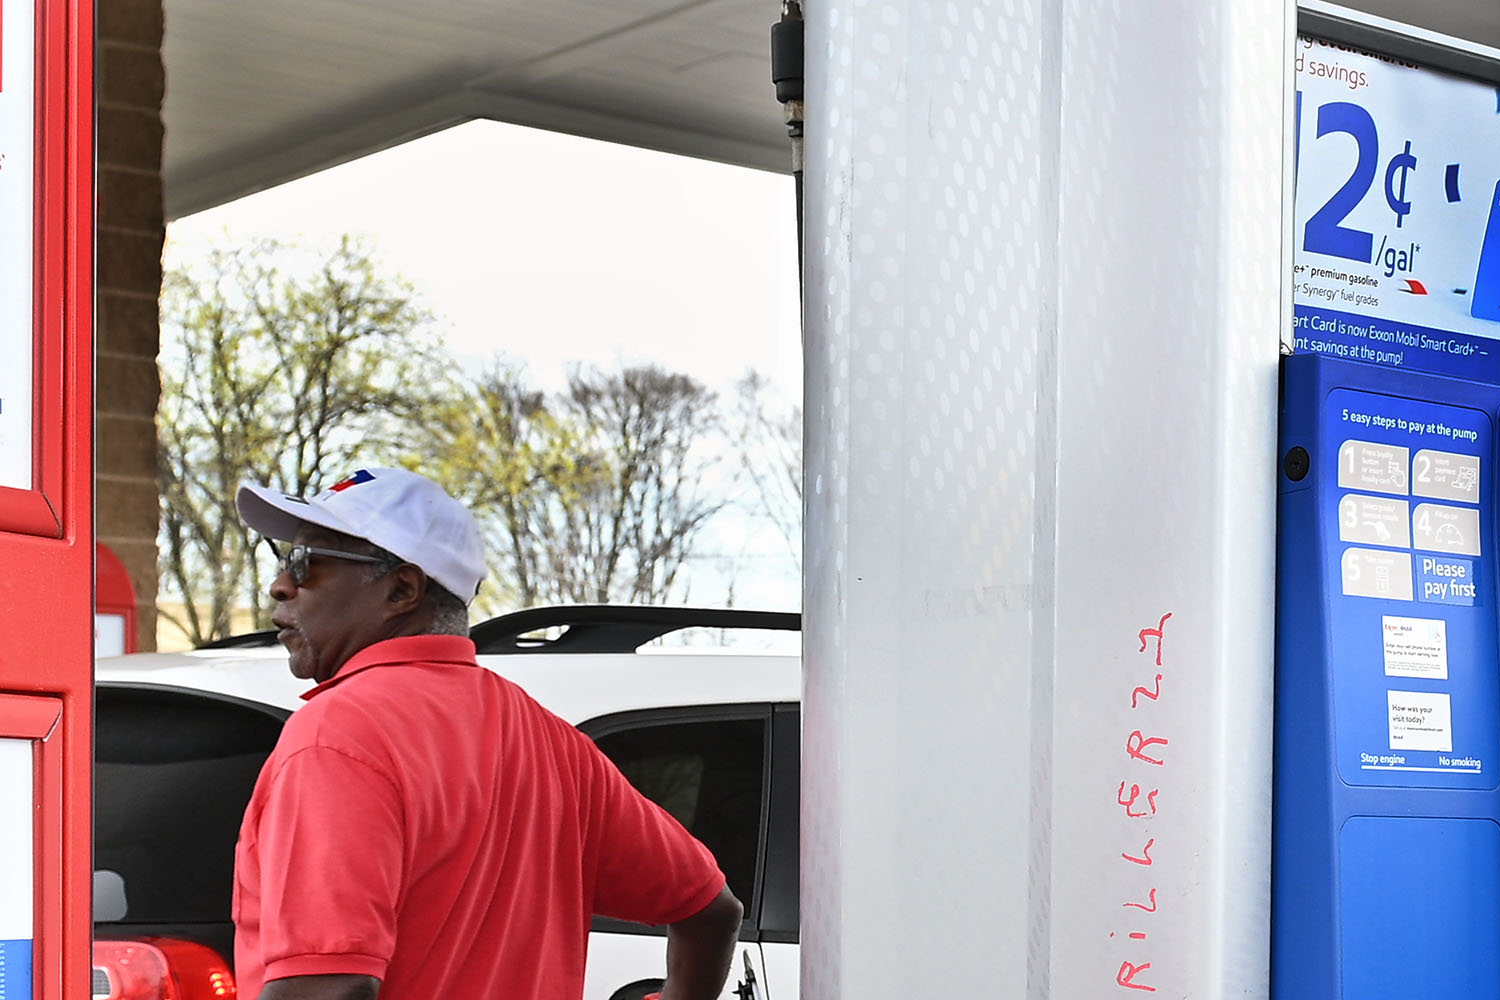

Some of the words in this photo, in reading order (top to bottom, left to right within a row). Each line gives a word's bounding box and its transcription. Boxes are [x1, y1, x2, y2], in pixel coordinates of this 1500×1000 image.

[1309, 60, 1369, 89] savings.
[1311, 267, 1347, 281] premium
[1349, 274, 1378, 287] gasoline
[1341, 290, 1354, 301] fuel
[1356, 295, 1378, 306] grades
[1311, 316, 1336, 332] Card
[1339, 322, 1345, 332] is
[1348, 325, 1368, 338] now
[1369, 326, 1394, 343] Exxon
[1395, 331, 1420, 347] Mobil
[1421, 336, 1446, 351] Smart
[1310, 340, 1348, 356] savings
[1350, 345, 1359, 356] at
[1361, 345, 1375, 360] the
[1377, 350, 1403, 365] pump!
[1342, 409, 1348, 420] 5
[1351, 413, 1371, 427] easy
[1373, 416, 1396, 430] steps
[1398, 419, 1407, 428] to
[1409, 422, 1425, 434] pay
[1427, 424, 1436, 433] at
[1437, 424, 1451, 436] the
[1453, 428, 1477, 442] pump
[1345, 447, 1354, 473] 1
[1418, 456, 1431, 483] 2
[1344, 501, 1357, 528] 3
[1417, 510, 1432, 536] 4
[1347, 555, 1360, 581] 5
[1423, 559, 1465, 577] Please
[1425, 582, 1447, 599] pay
[1450, 579, 1476, 597] first
[1361, 753, 1378, 764] Stop
[1380, 755, 1405, 765] engine
[1439, 757, 1449, 765] No
[1451, 757, 1481, 769] smoking
